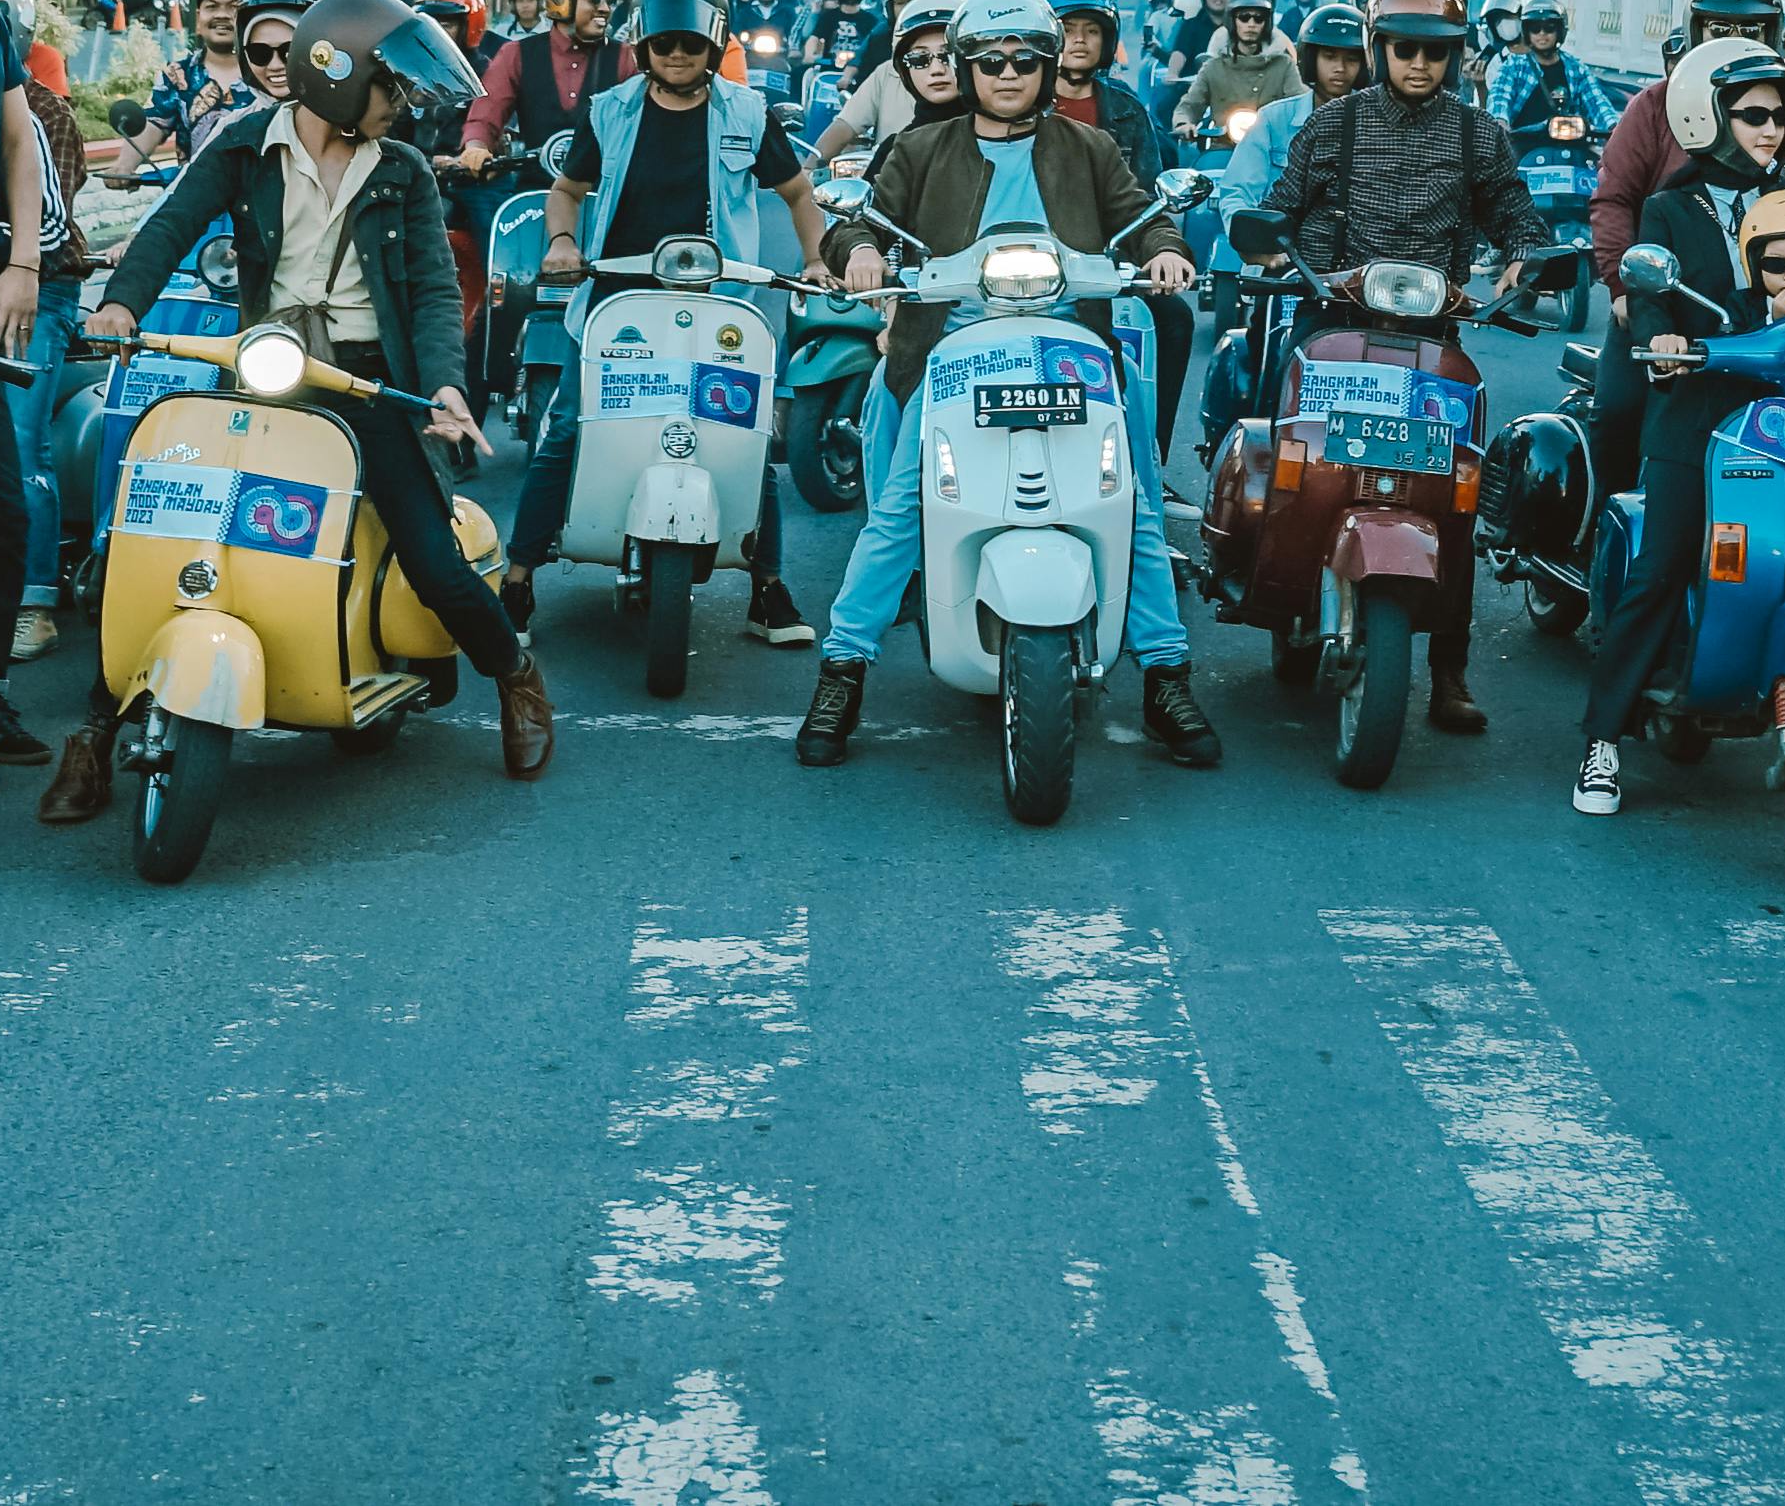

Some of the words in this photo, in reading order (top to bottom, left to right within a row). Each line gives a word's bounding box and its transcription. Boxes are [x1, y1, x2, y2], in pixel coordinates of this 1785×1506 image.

[987, 6, 1029, 20] Vespa
[603, 349, 653, 359] vespa
[930, 349, 1008, 379] BANGKALAN
[127, 370, 188, 386] BANGKALAN
[601, 373, 669, 386] BANGKALAN
[931, 370, 970, 389] MODS
[973, 357, 1033, 378] MAYDAY
[601, 386, 636, 398] MODS
[638, 384, 689, 397] MAYDAY
[1301, 374, 1379, 391] BANGKALAN
[932, 383, 967, 403] 2023
[980, 391, 992, 408] L
[1001, 388, 1050, 407] 2260
[1055, 388, 1082, 406] LN
[1300, 388, 1340, 402] MODS
[1343, 389, 1401, 405] MAYDAY
[601, 397, 632, 410] 2023
[1037, 412, 1051, 422] 07
[1062, 412, 1077, 422] 24
[1328, 416, 1345, 437] M
[1360, 419, 1410, 444] 6428
[1426, 426, 1451, 449] HN
[1426, 454, 1447, 468] 25
[129, 478, 204, 497] BANGKALAN
[126, 493, 161, 510] MODS
[162, 496, 224, 515] MAYDAY
[124, 508, 154, 525] 2023
